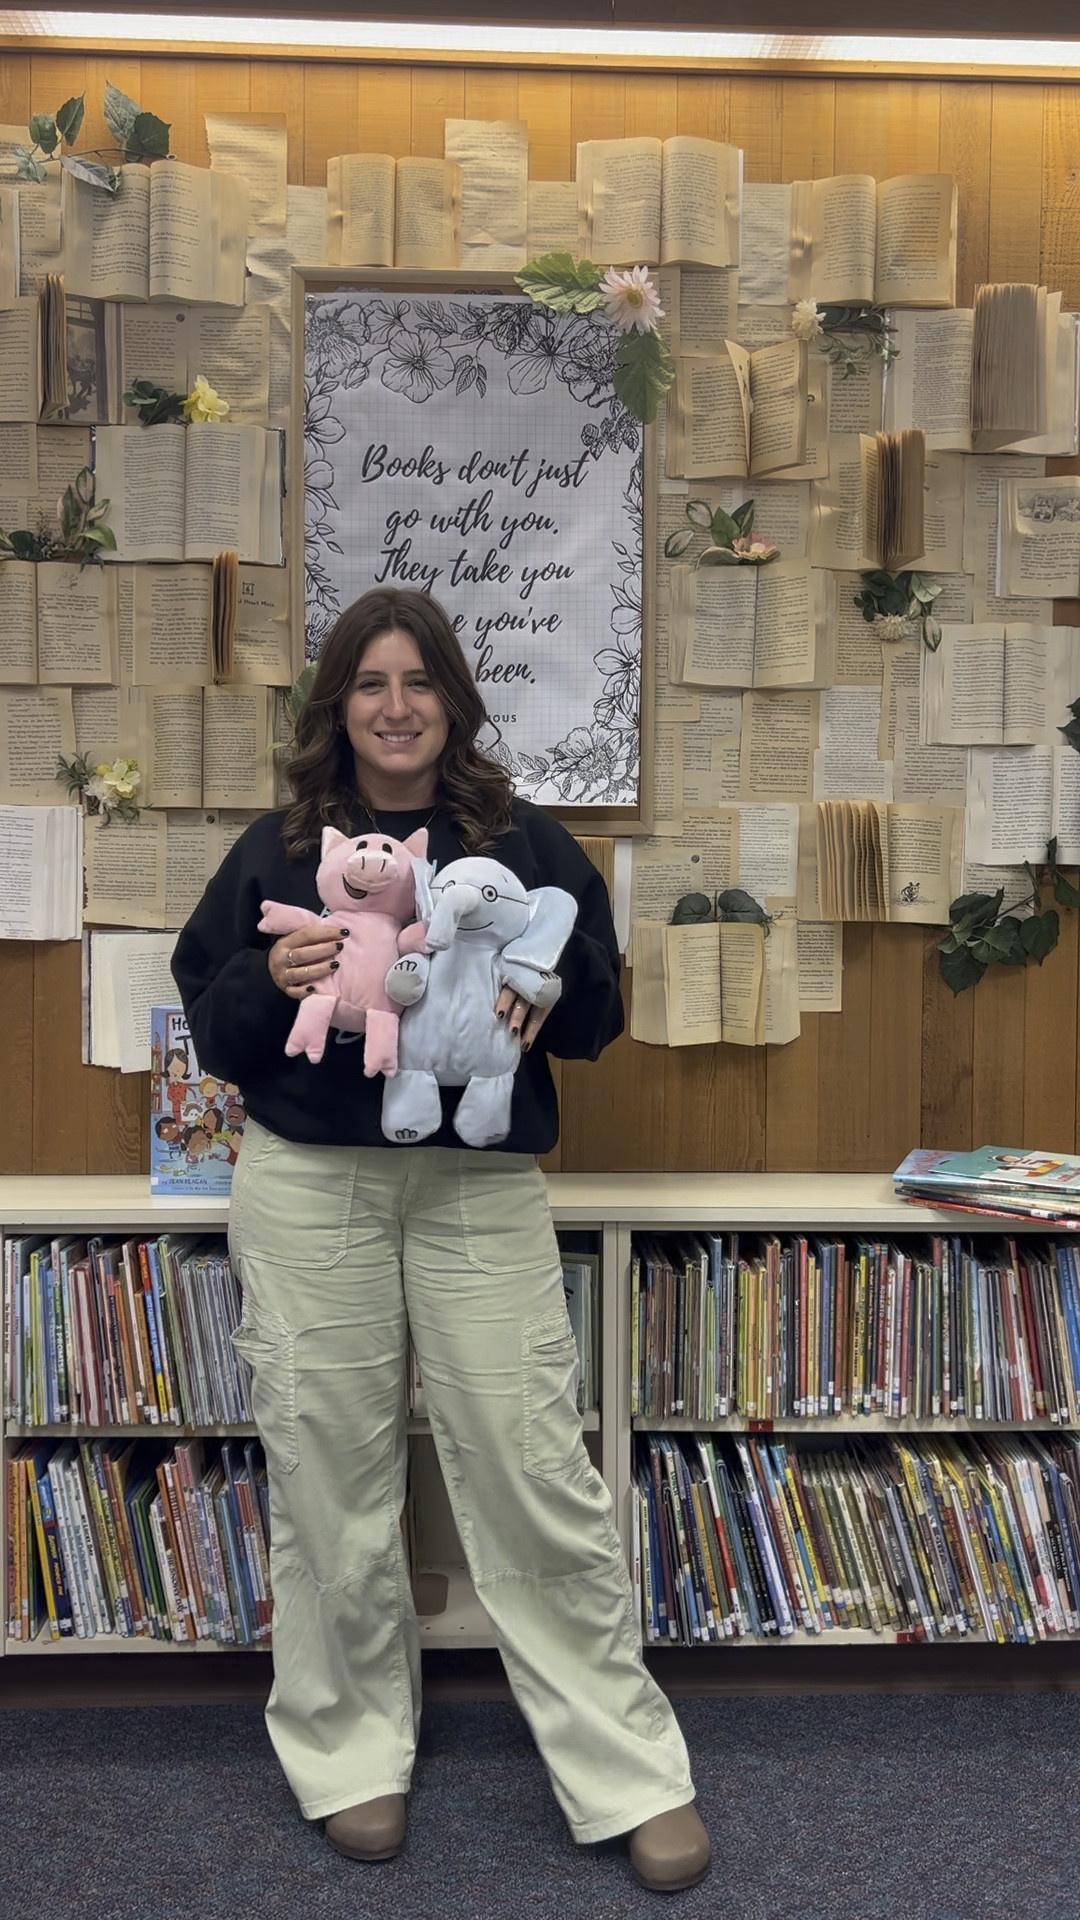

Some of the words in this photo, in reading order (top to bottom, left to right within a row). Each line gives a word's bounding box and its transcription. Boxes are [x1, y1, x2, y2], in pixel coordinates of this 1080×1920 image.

[361, 443, 451, 485] Books
[458, 448, 530, 487] don't
[525, 449, 590, 499] just
[384, 508, 422, 546] go
[429, 489, 494, 537] with
[499, 511, 559, 550] you.
[374, 537, 444, 598] They
[449, 548, 514, 588] take
[519, 561, 575, 600] you
[473, 606, 563, 650] you've
[474, 644, 536, 684] been.
[55, 1332, 64, 1372] PROMISE
[82, 1524, 90, 1543] LUCKY
[169, 1567, 180, 1596] SNOWY
[175, 1598, 184, 1613] DAY
